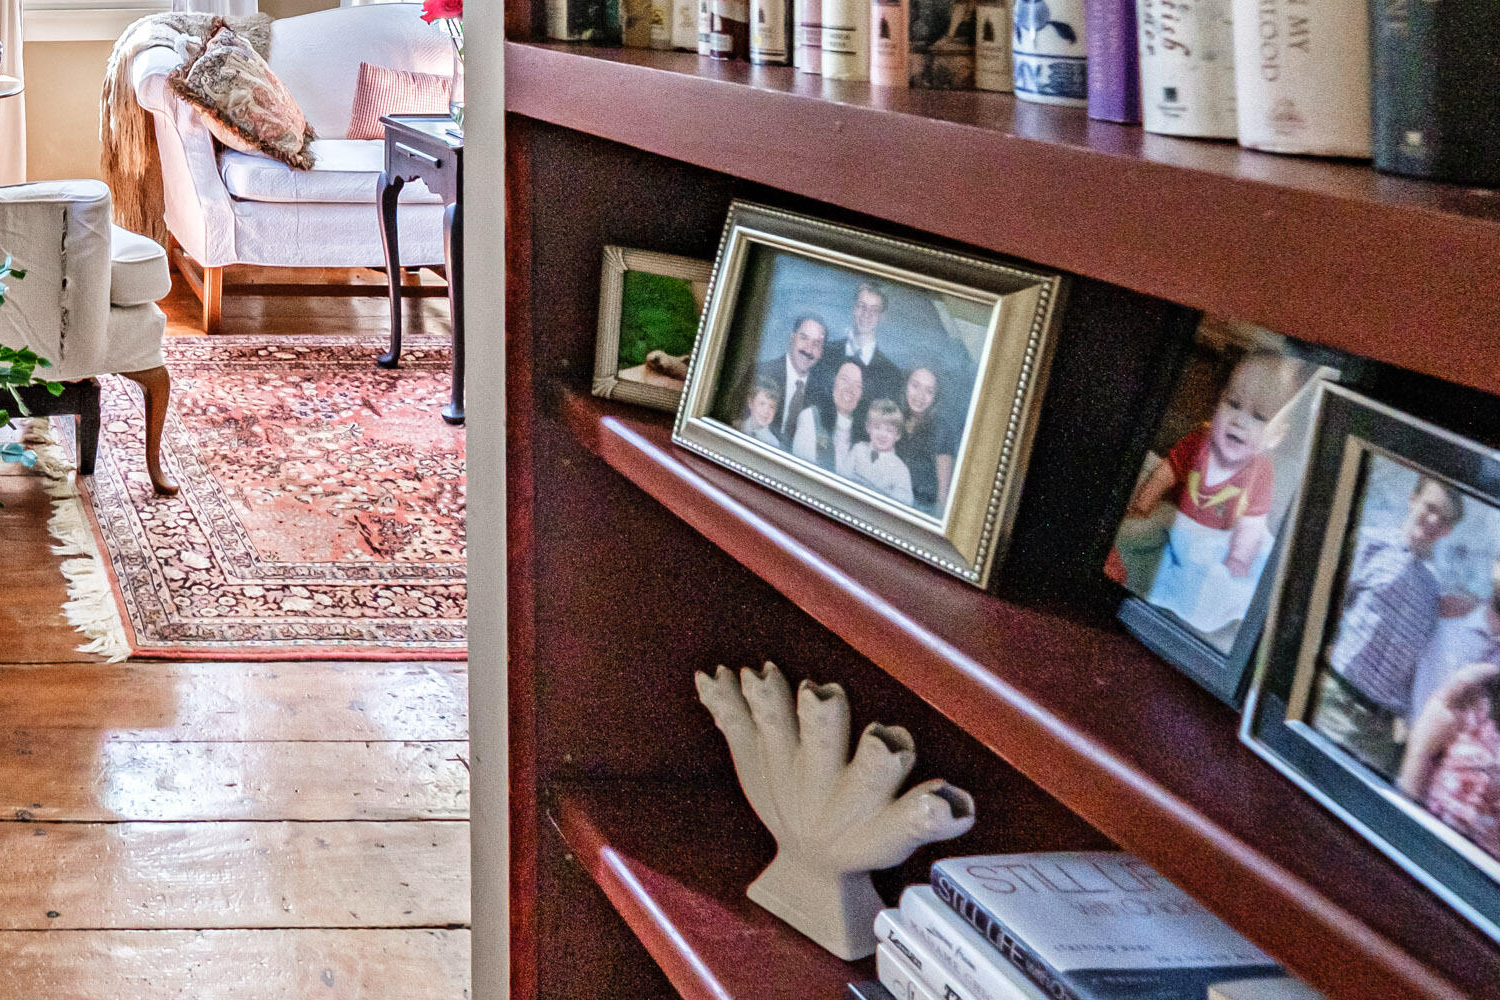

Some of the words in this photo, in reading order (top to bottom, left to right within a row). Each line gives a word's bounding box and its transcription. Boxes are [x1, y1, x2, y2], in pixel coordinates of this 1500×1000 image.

[1285, 14, 1311, 55] MY
[965, 858, 1109, 896] STILL
[936, 873, 993, 938] STILL
